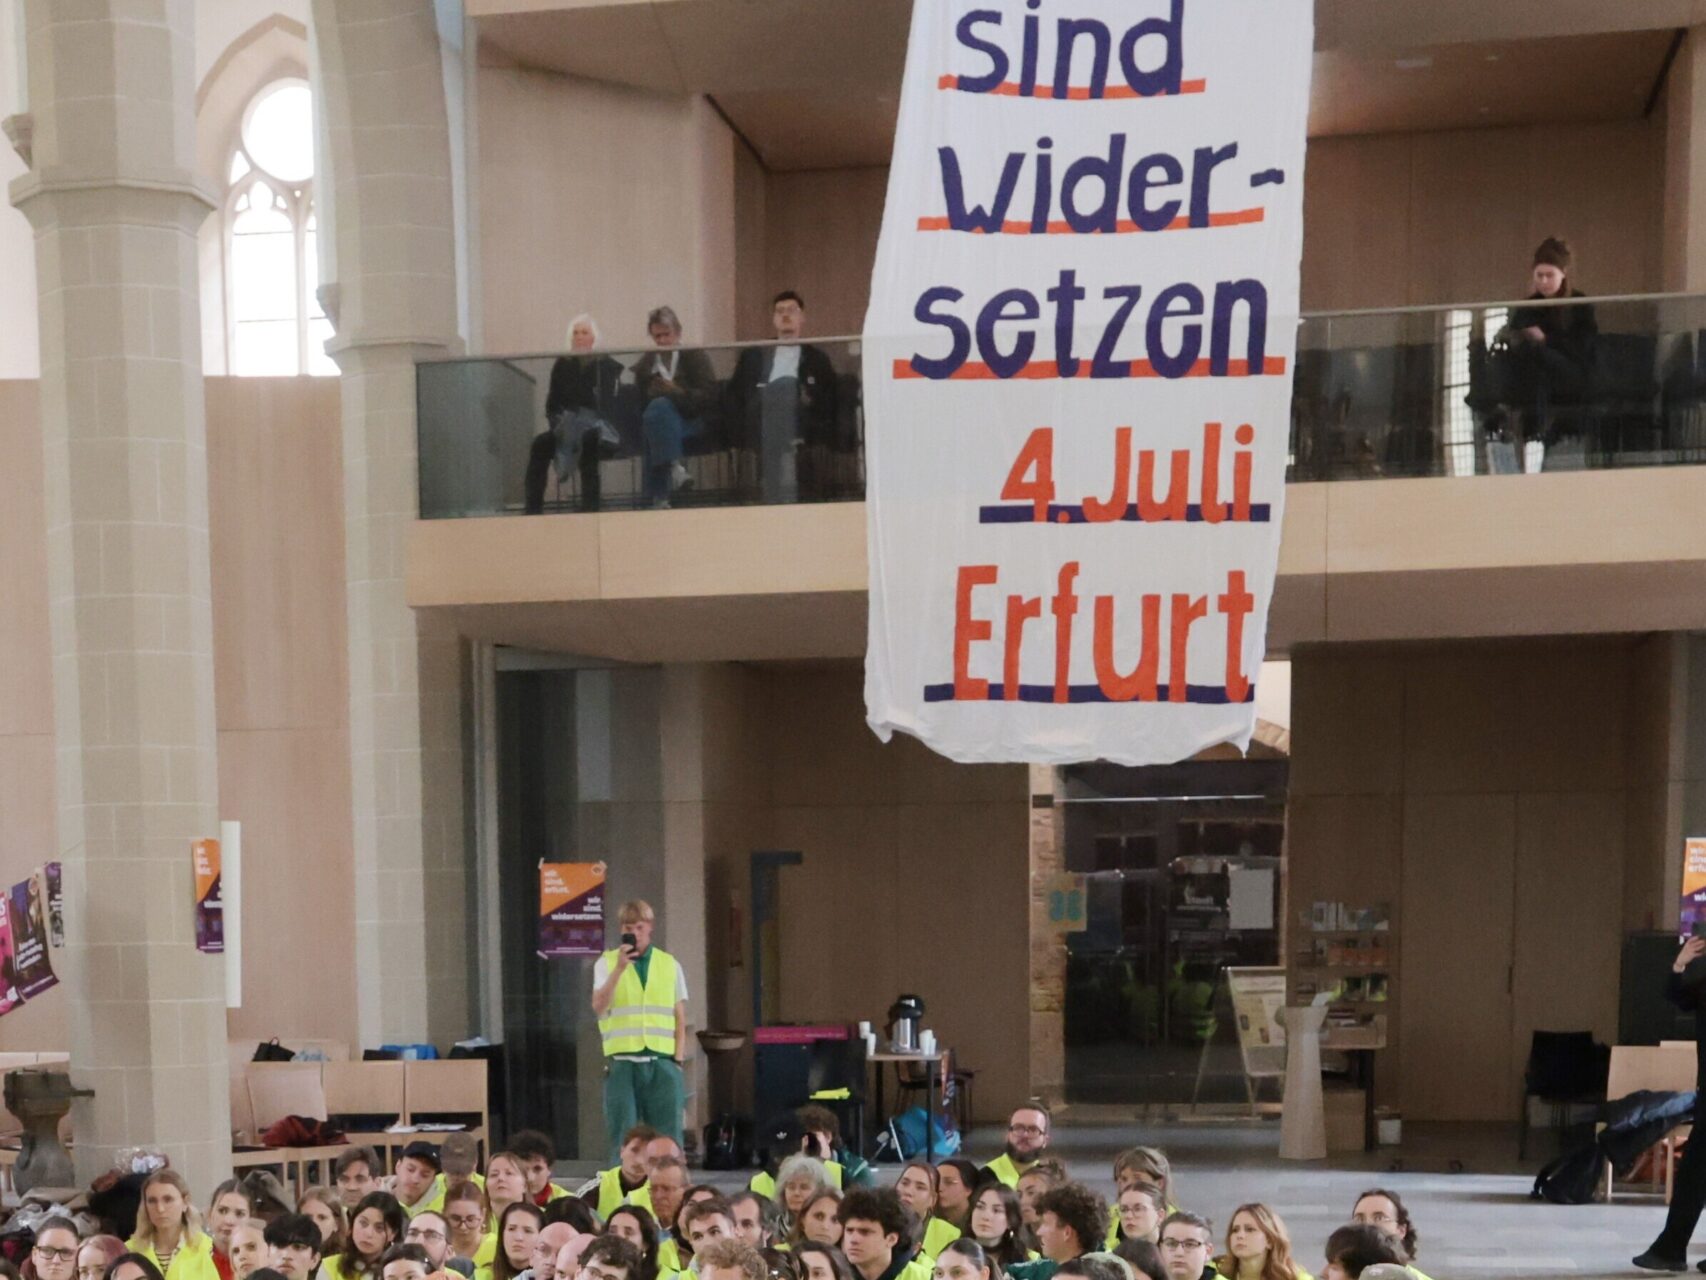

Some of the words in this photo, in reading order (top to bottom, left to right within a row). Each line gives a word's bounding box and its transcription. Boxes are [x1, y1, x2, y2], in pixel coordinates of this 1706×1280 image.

[955, 0, 1184, 99] sind
[911, 269, 1267, 380] setzen
[954, 561, 1254, 703] Erfurt
